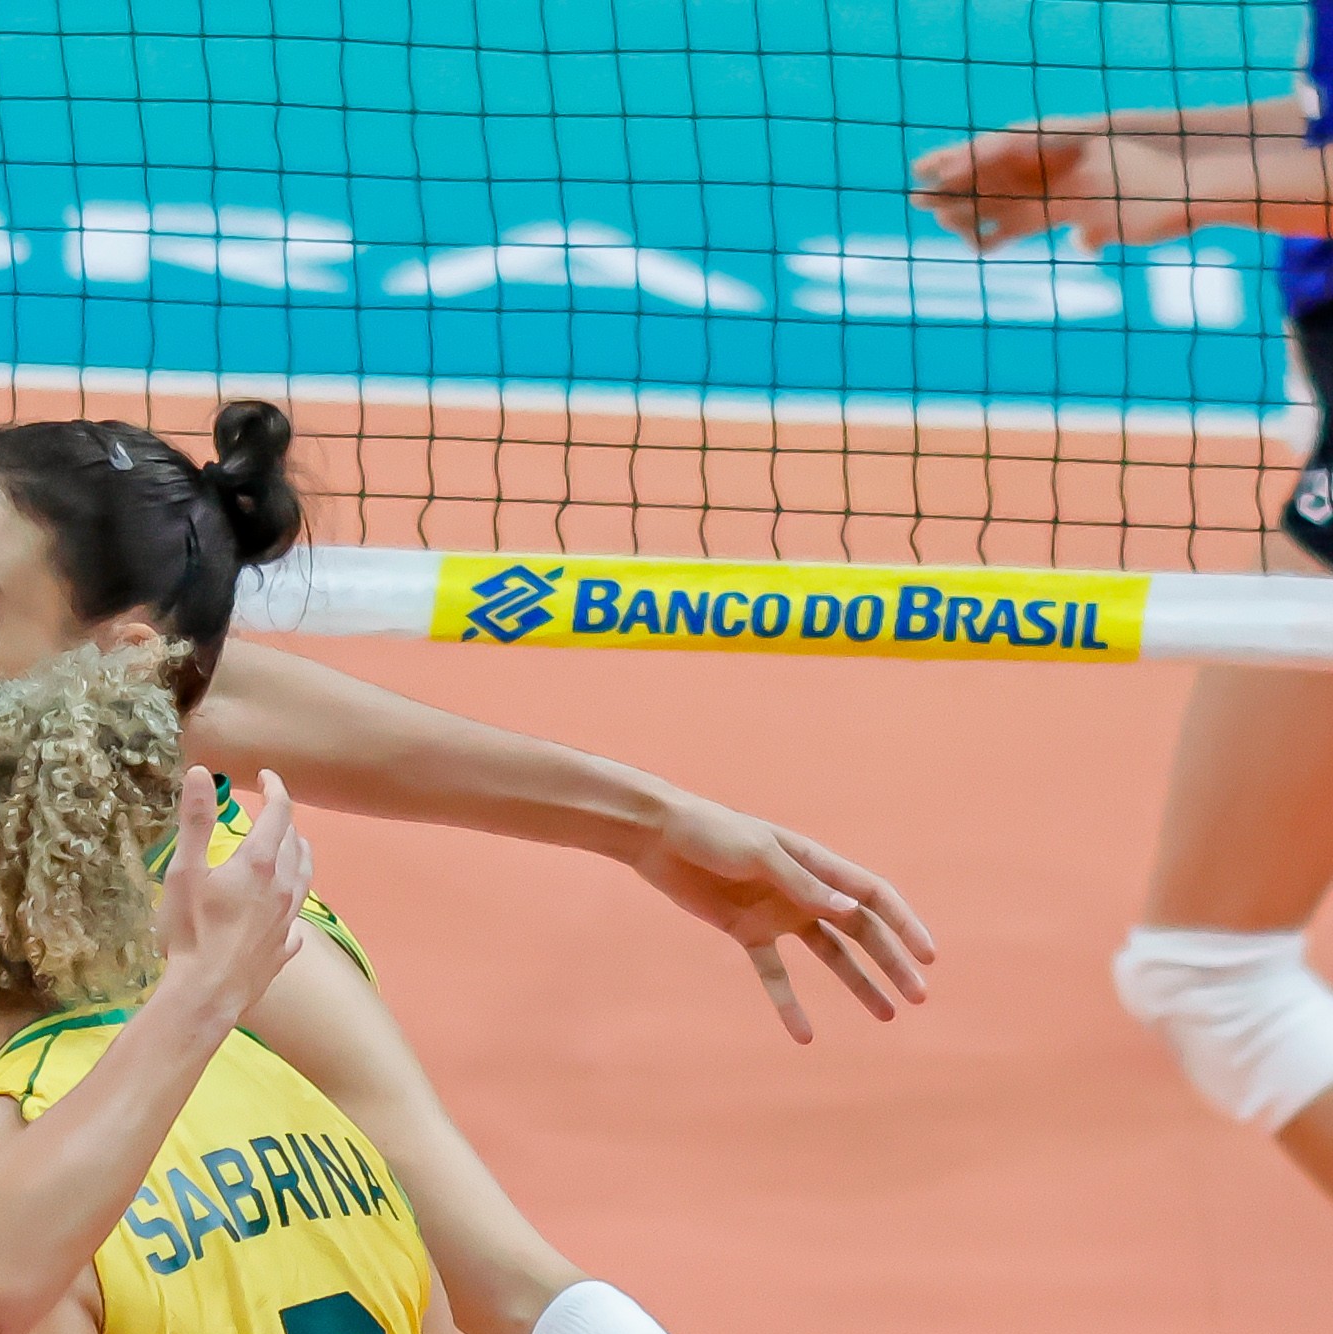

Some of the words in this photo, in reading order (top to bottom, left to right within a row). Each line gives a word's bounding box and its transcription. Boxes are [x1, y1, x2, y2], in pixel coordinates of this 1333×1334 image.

[572, 578, 791, 639] BANCO
[801, 593, 884, 641] DO
[895, 585, 1109, 650] BRASIL
[124, 1133, 400, 1275] SABRINA
